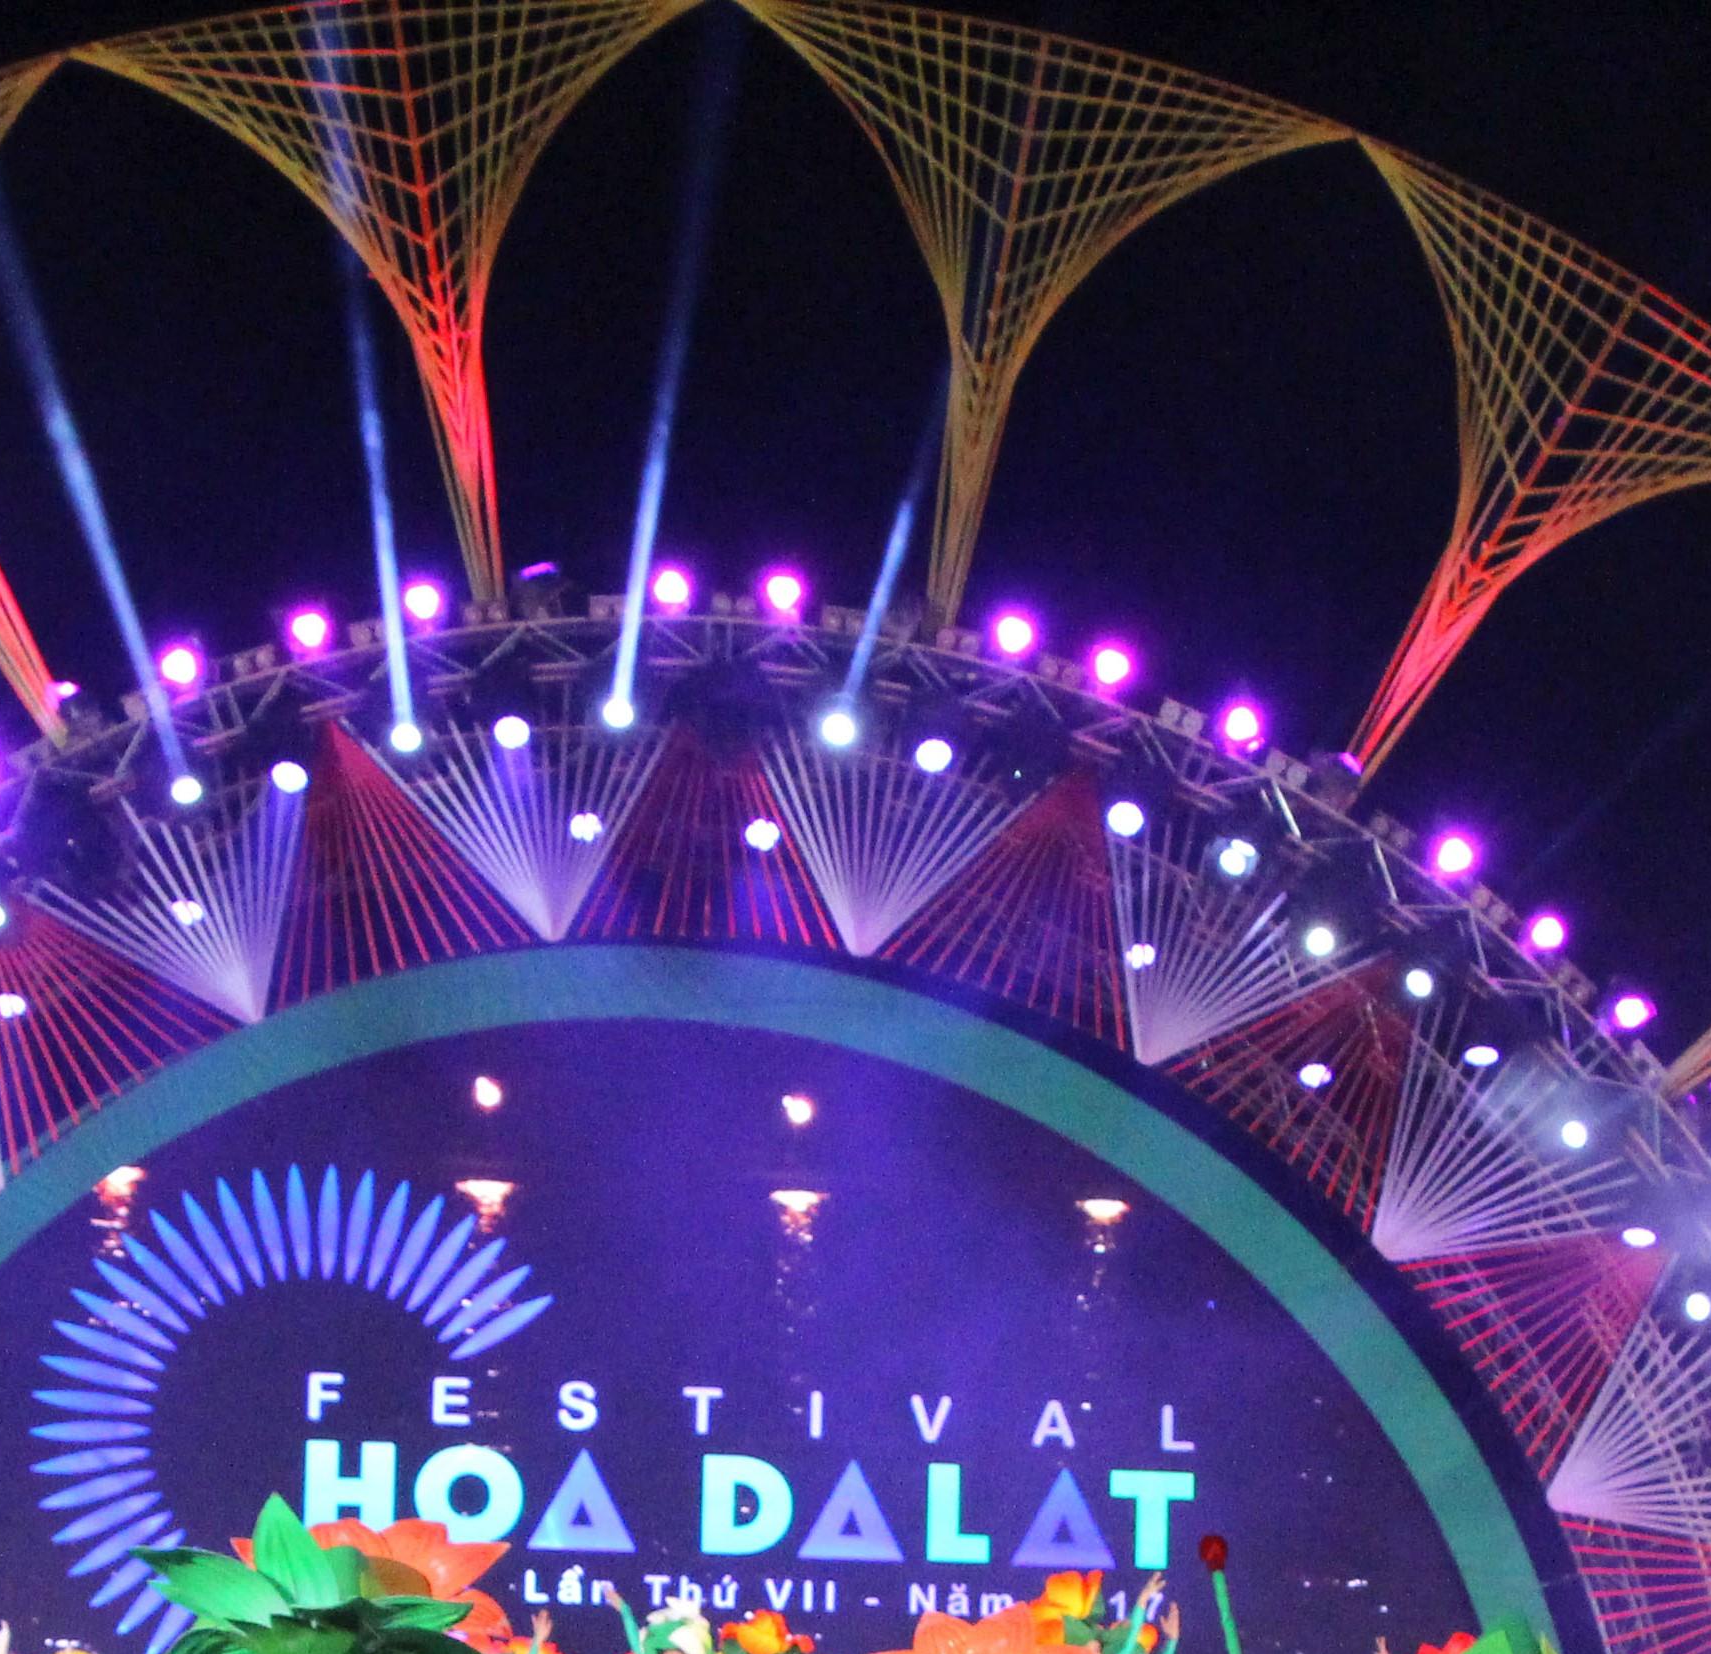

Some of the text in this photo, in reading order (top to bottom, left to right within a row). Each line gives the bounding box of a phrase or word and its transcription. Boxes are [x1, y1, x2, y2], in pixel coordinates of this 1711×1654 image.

[305, 1371, 1195, 1452] FESTIVAL
[301, 1437, 1197, 1570] HOA DALAT
[763, 1577, 838, 1613] VII
